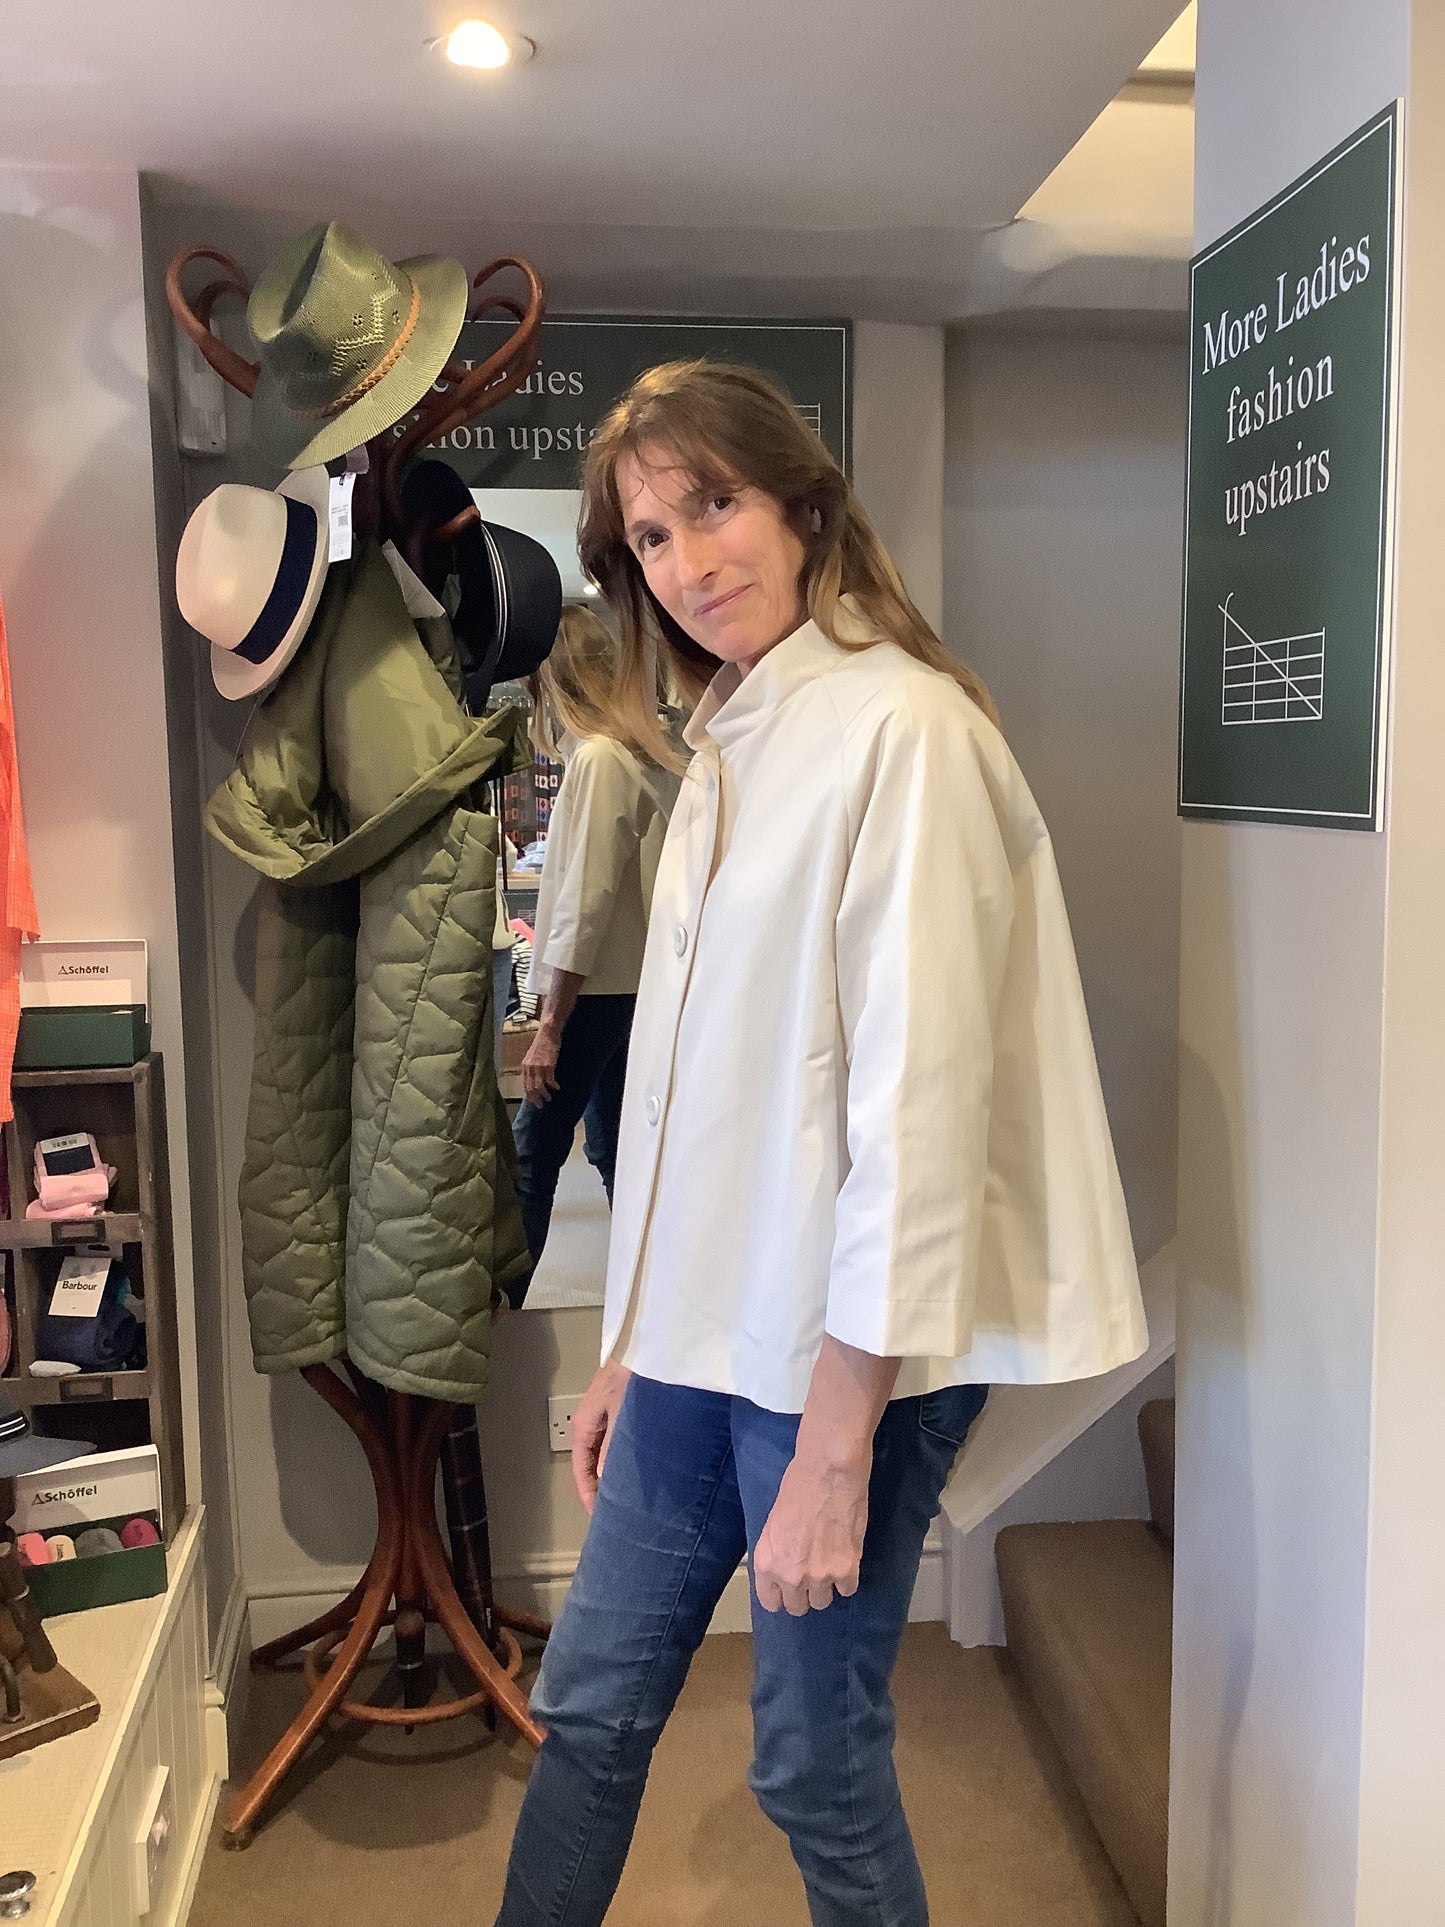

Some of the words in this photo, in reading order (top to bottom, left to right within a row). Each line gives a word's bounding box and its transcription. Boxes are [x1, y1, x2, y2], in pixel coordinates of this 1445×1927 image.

[1202, 303, 1268, 376] More
[1274, 234, 1371, 333] Ladies
[1226, 354, 1335, 444] fashion
[1224, 440, 1331, 536] upstairs
[68, 965, 109, 975] Schöffel
[62, 1280, 97, 1290] Barbour
[44, 1485, 97, 1502] Schöffel
